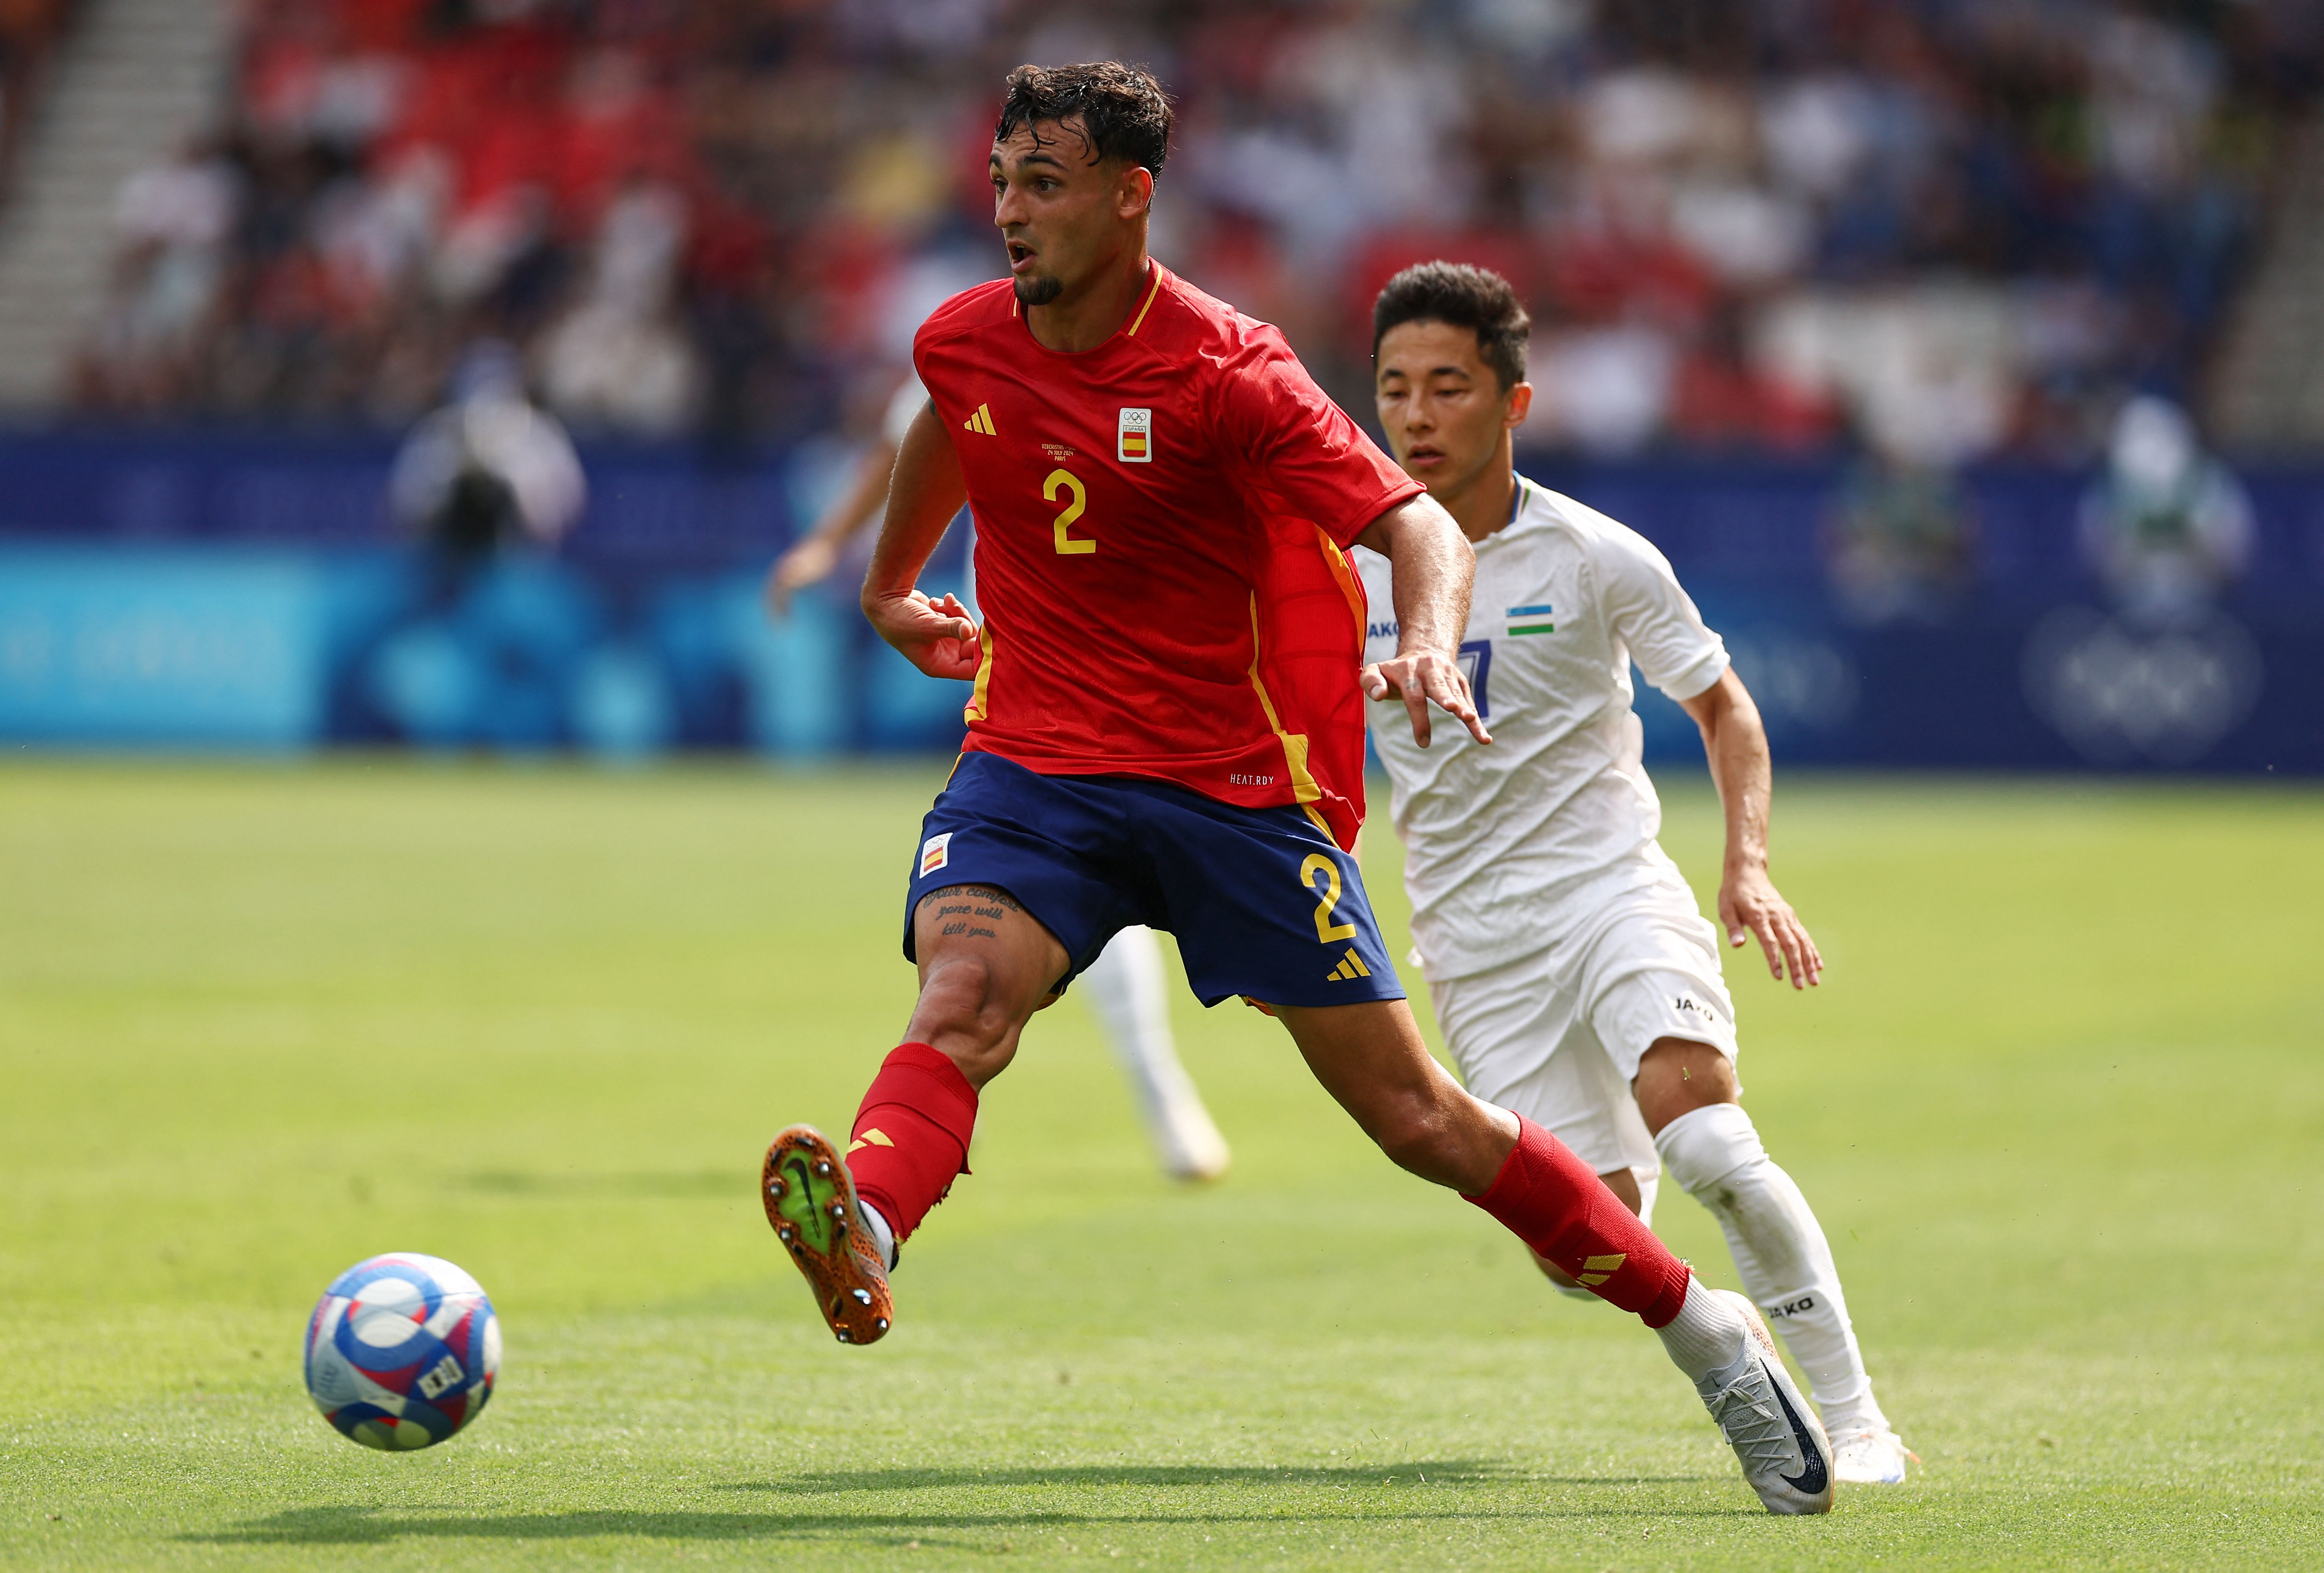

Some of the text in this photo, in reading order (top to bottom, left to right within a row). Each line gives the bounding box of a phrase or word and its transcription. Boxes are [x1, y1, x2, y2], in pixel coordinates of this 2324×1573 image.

[1043, 469, 1096, 554] 2
[1368, 622, 1398, 637] AK
[1230, 774, 1274, 785] HEAT.RDY
[1300, 853, 1357, 943] 2
[975, 906, 1003, 920] will
[942, 922, 995, 938] kill you
[1675, 998, 1713, 1021] JAO
